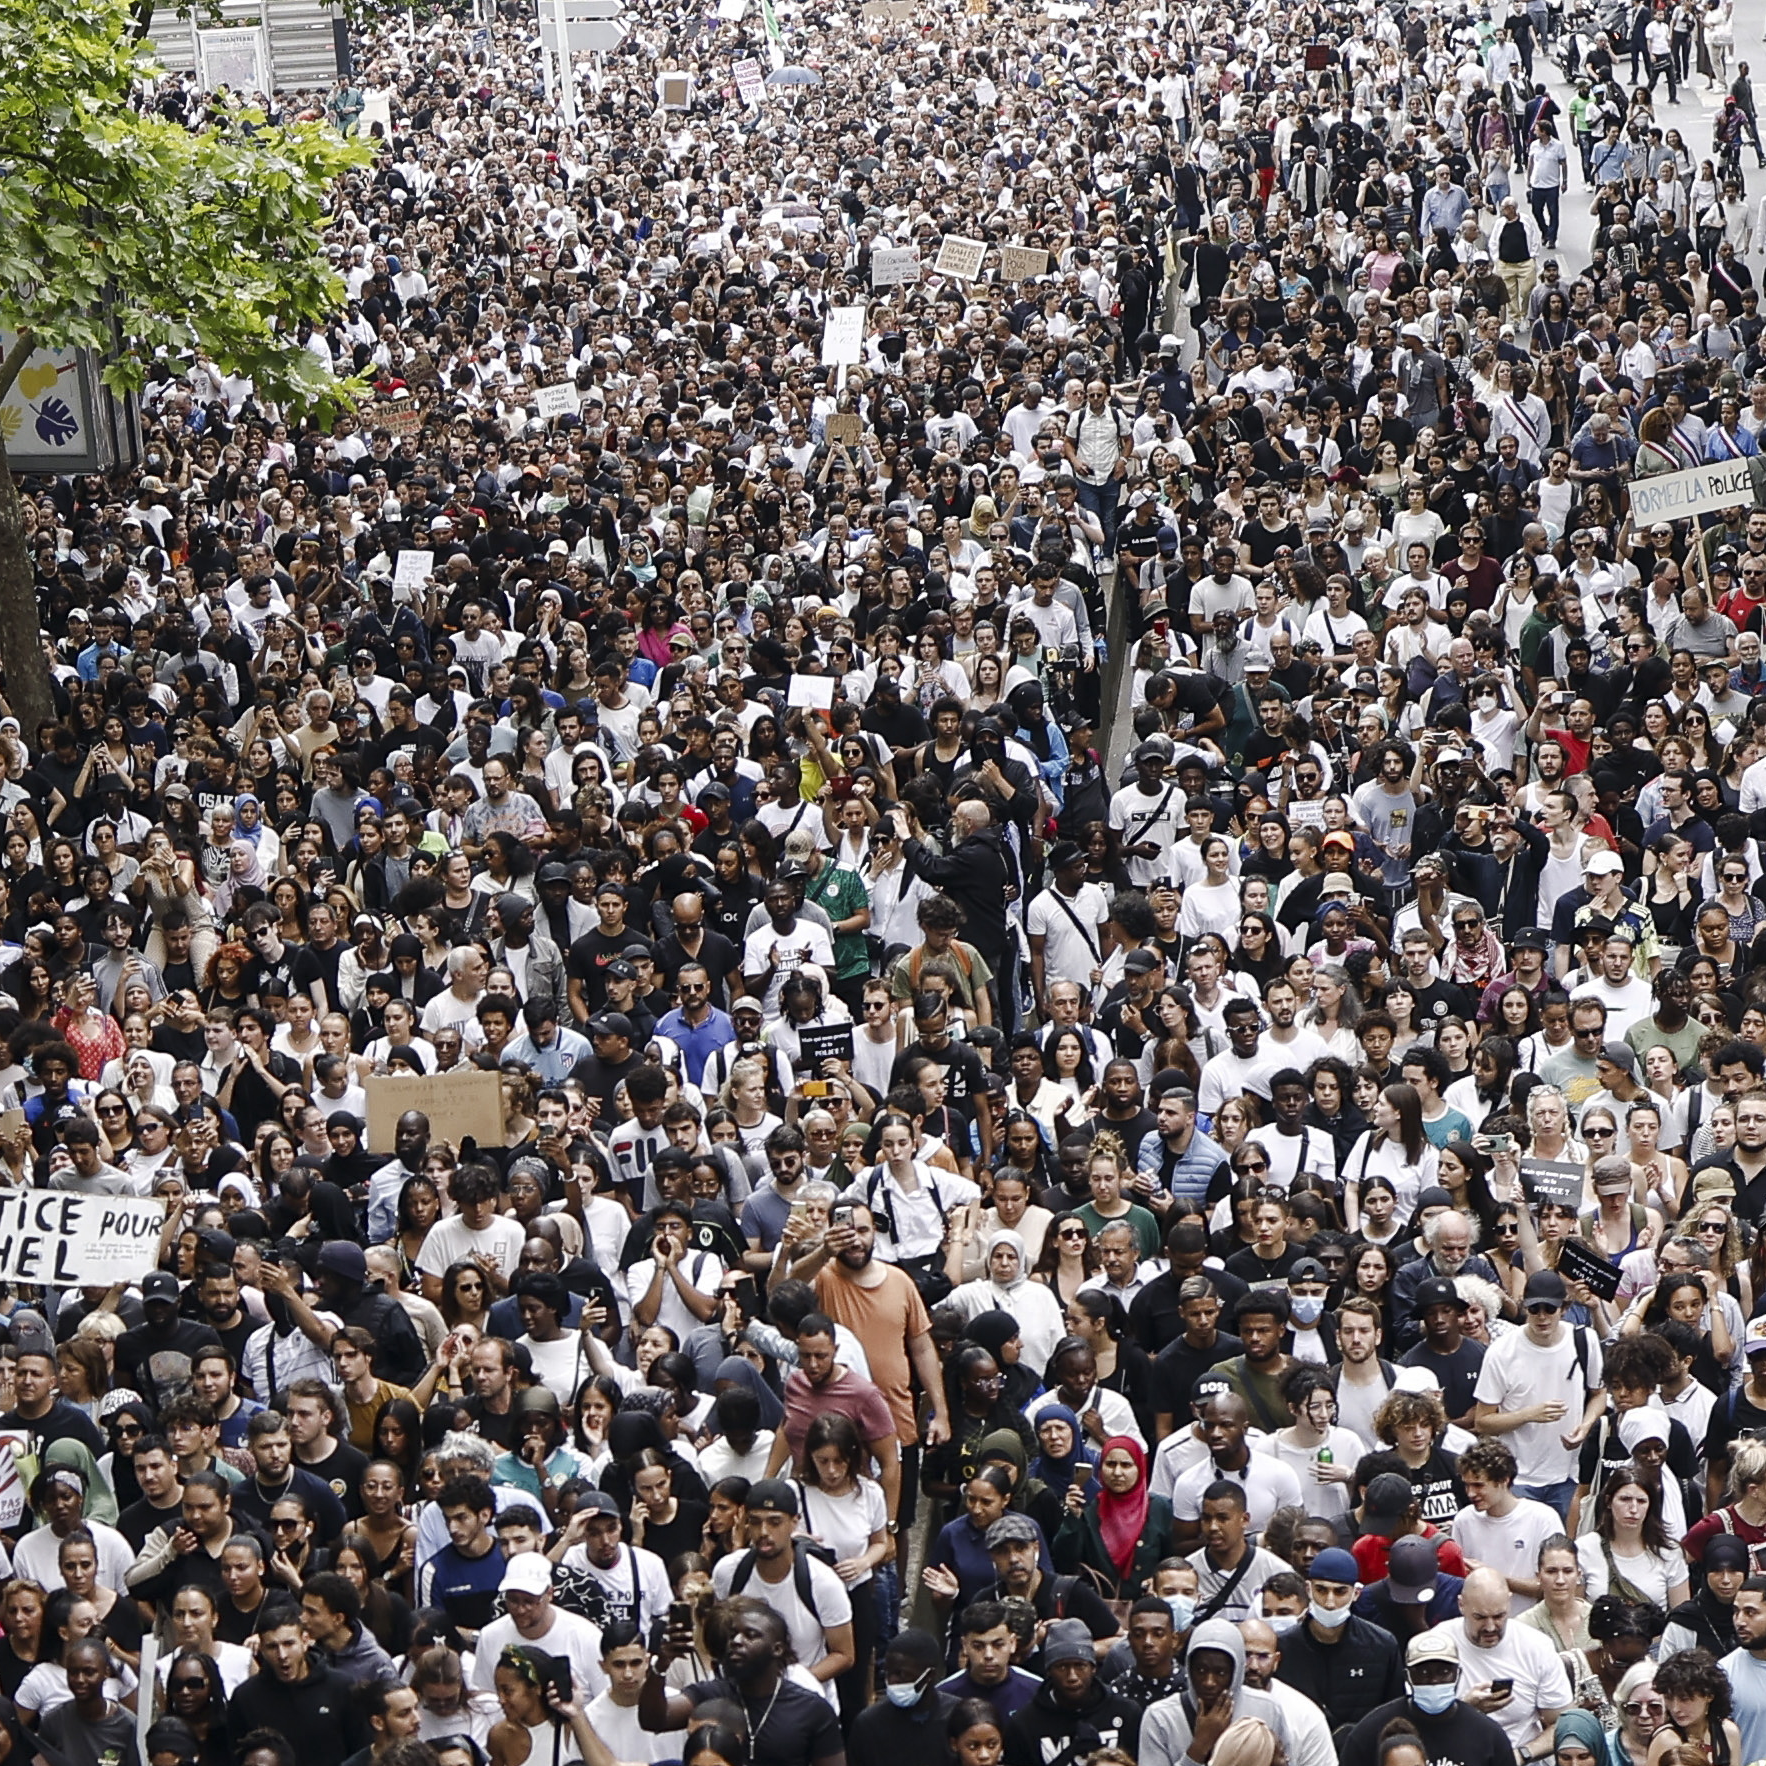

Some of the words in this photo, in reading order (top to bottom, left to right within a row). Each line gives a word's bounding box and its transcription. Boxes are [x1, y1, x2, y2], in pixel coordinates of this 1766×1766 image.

[1633, 486, 1683, 517] FORMEZ
[1686, 477, 1705, 502] LA
[1708, 470, 1752, 497] POLICE
[1534, 1185, 1563, 1196] POLICE
[100, 1210, 163, 1240] POUR
[1200, 1381, 1229, 1394] BOSS
